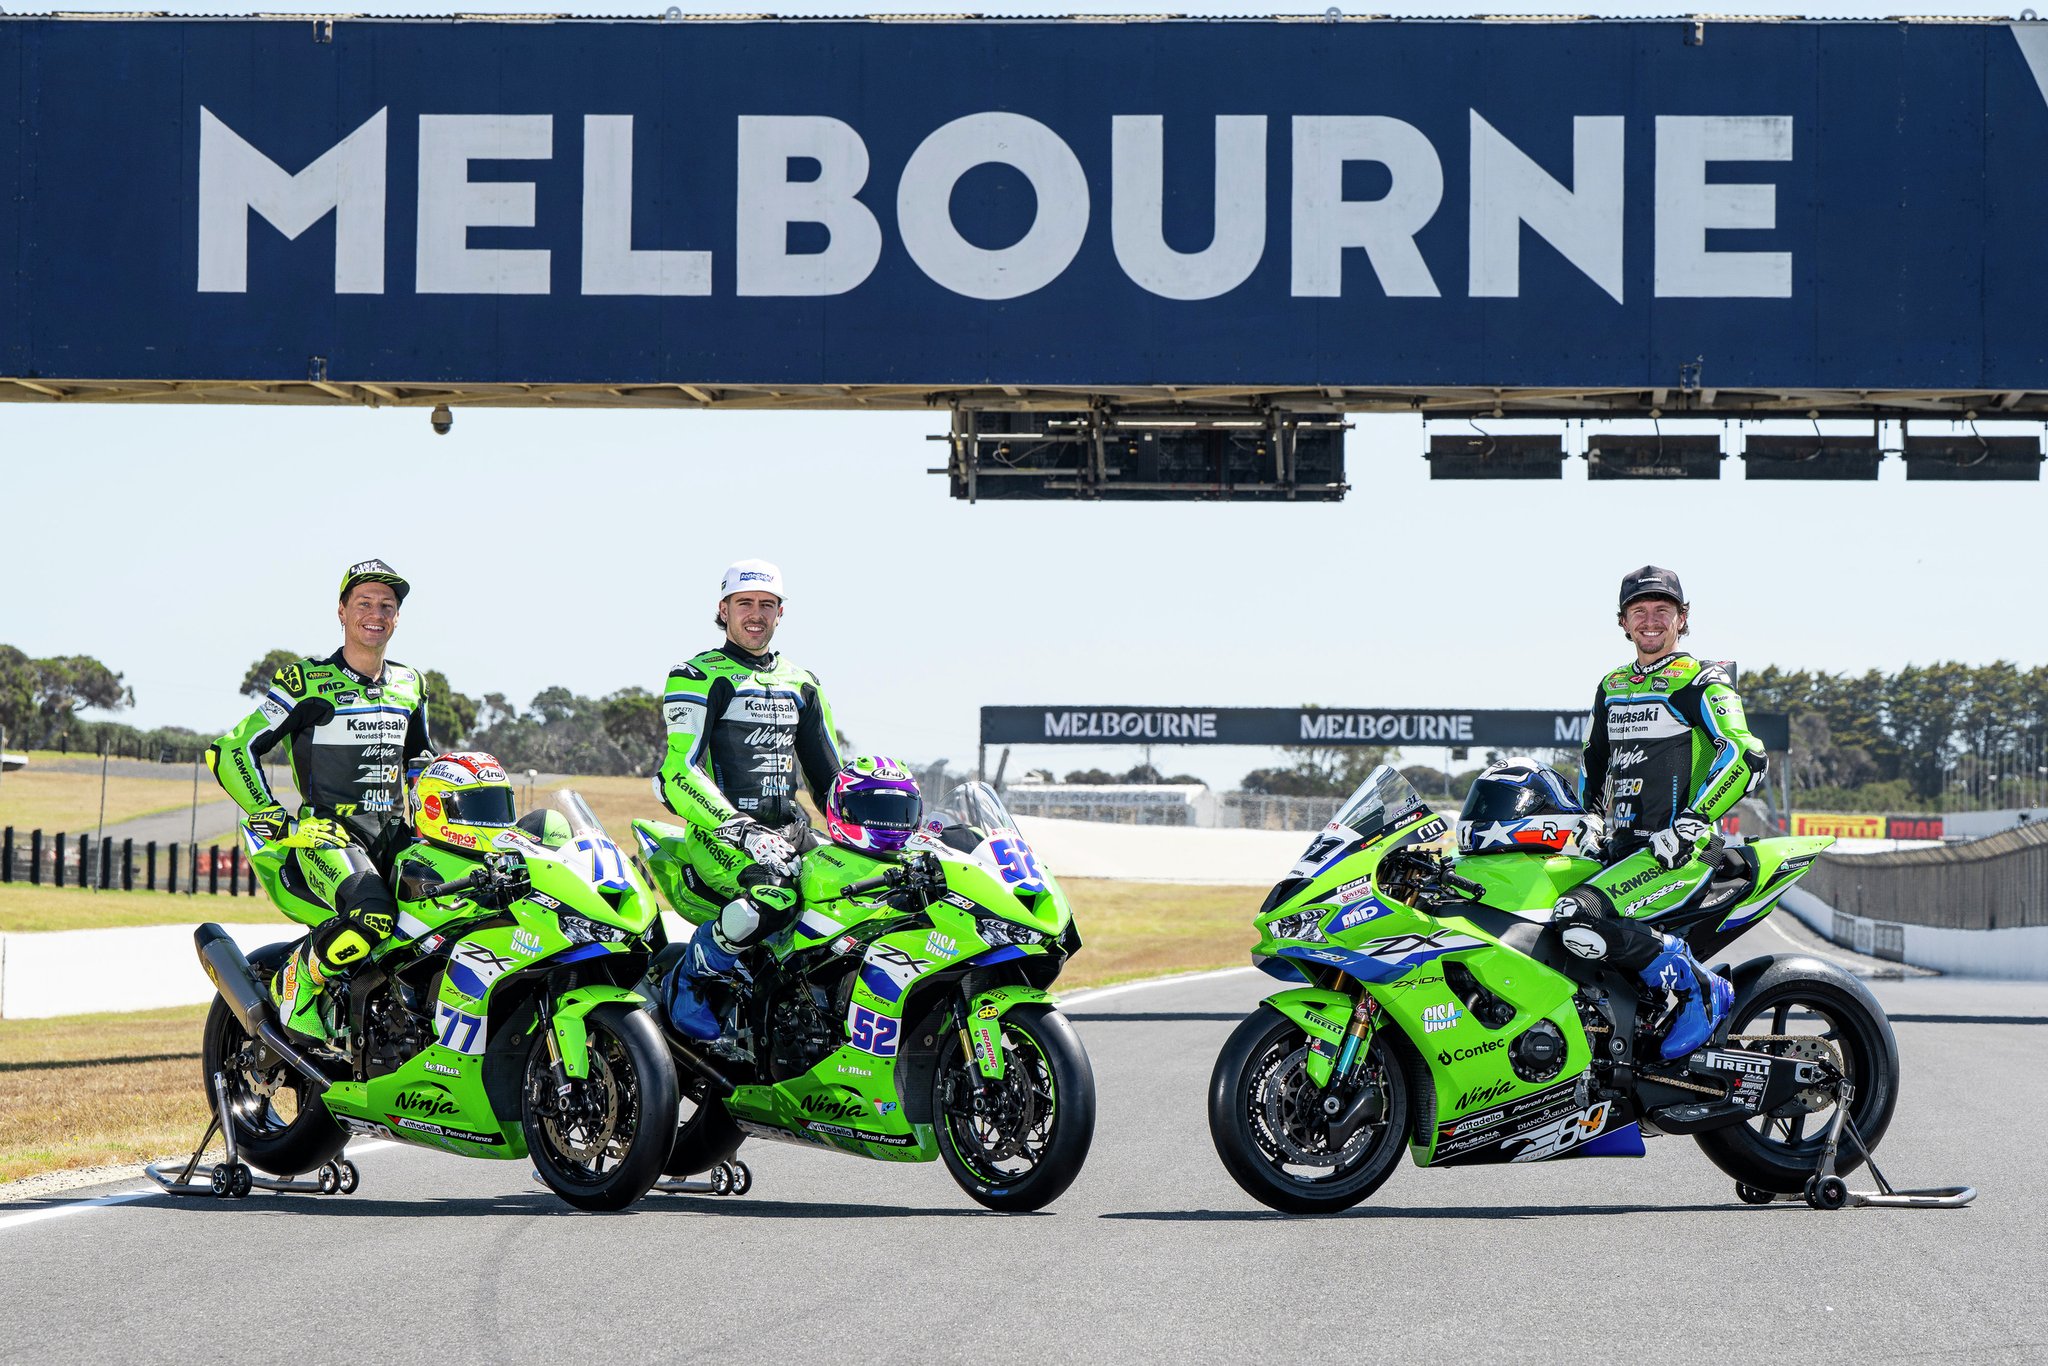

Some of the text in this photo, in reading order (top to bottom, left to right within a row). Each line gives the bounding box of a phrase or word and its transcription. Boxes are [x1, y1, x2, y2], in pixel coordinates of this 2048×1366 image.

[195, 105, 1795, 305] MELBOURNE
[346, 719, 407, 731] Kawasaki
[1044, 711, 1217, 738] MELBOURNE
[1299, 714, 1475, 741] MELBOURNE
[744, 726, 794, 751] Ninja
[362, 745, 397, 760] Ninja
[231, 747, 269, 806] Kawasaki
[1699, 765, 1745, 815] Kawasaki
[335, 803, 358, 818] 77
[671, 772, 731, 823] Kawasaki
[738, 798, 759, 810] 52
[1417, 819, 1445, 839] rin
[1797, 817, 1879, 839] PIRELLI
[575, 838, 625, 882] 77
[690, 823, 741, 871] Kawasaki
[989, 838, 1044, 883] 52
[1336, 875, 1367, 894] Ferrari
[1606, 864, 1671, 900] Kawasa
[1624, 880, 1686, 917] alpinestars
[510, 929, 541, 958] CISA
[925, 930, 957, 960] CISA
[1367, 928, 1454, 957] ZX
[1391, 976, 1445, 989] ZX-10R
[978, 1006, 998, 1019] sbs
[1304, 1010, 1345, 1035] PIRELLI
[1423, 1002, 1458, 1034] CISA
[439, 1004, 482, 1053] 77
[851, 1006, 898, 1055] 52
[981, 1028, 998, 1069] BRAKING
[1453, 1038, 1506, 1061] Contec
[1706, 1051, 1771, 1075] PIRELLI
[395, 1091, 461, 1118] Ninja
[800, 1094, 869, 1120] Ninja
[1455, 1079, 1517, 1111] Ninja
[466, 1133, 493, 1143] Firenze
[879, 1136, 907, 1145] Firenze
